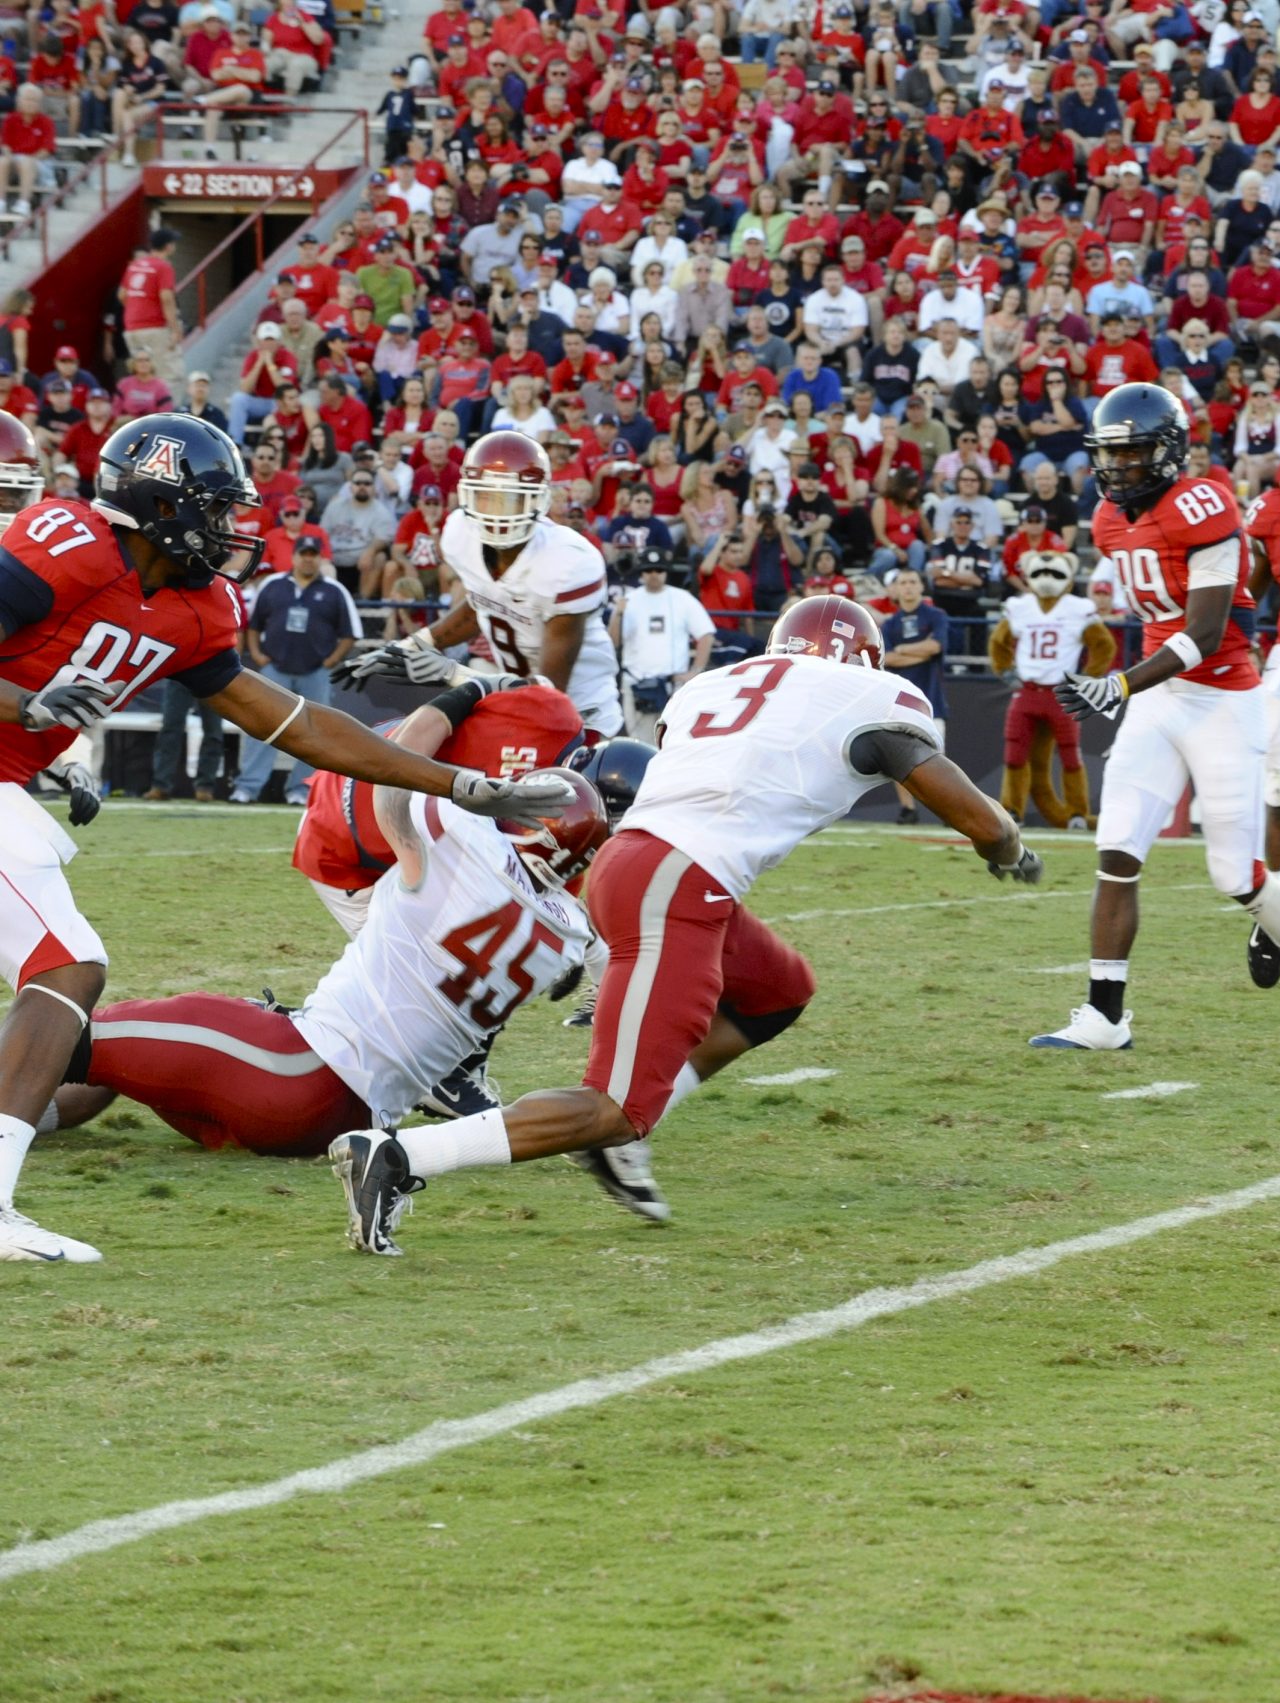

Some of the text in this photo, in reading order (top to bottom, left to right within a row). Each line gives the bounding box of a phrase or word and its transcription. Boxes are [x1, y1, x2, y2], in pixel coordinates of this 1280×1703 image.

[181, 173, 203, 195] 22
[206, 174, 273, 196] SECTION
[135, 434, 186, 487] A
[1174, 484, 1226, 526] 89
[26, 506, 97, 558] 87
[1110, 548, 1186, 624] 89
[36, 620, 178, 713] 87
[489, 614, 531, 679] 9
[826, 637, 846, 663] 3
[1029, 630, 1058, 660] 12
[690, 657, 795, 739] 3
[435, 898, 565, 1030] 45
